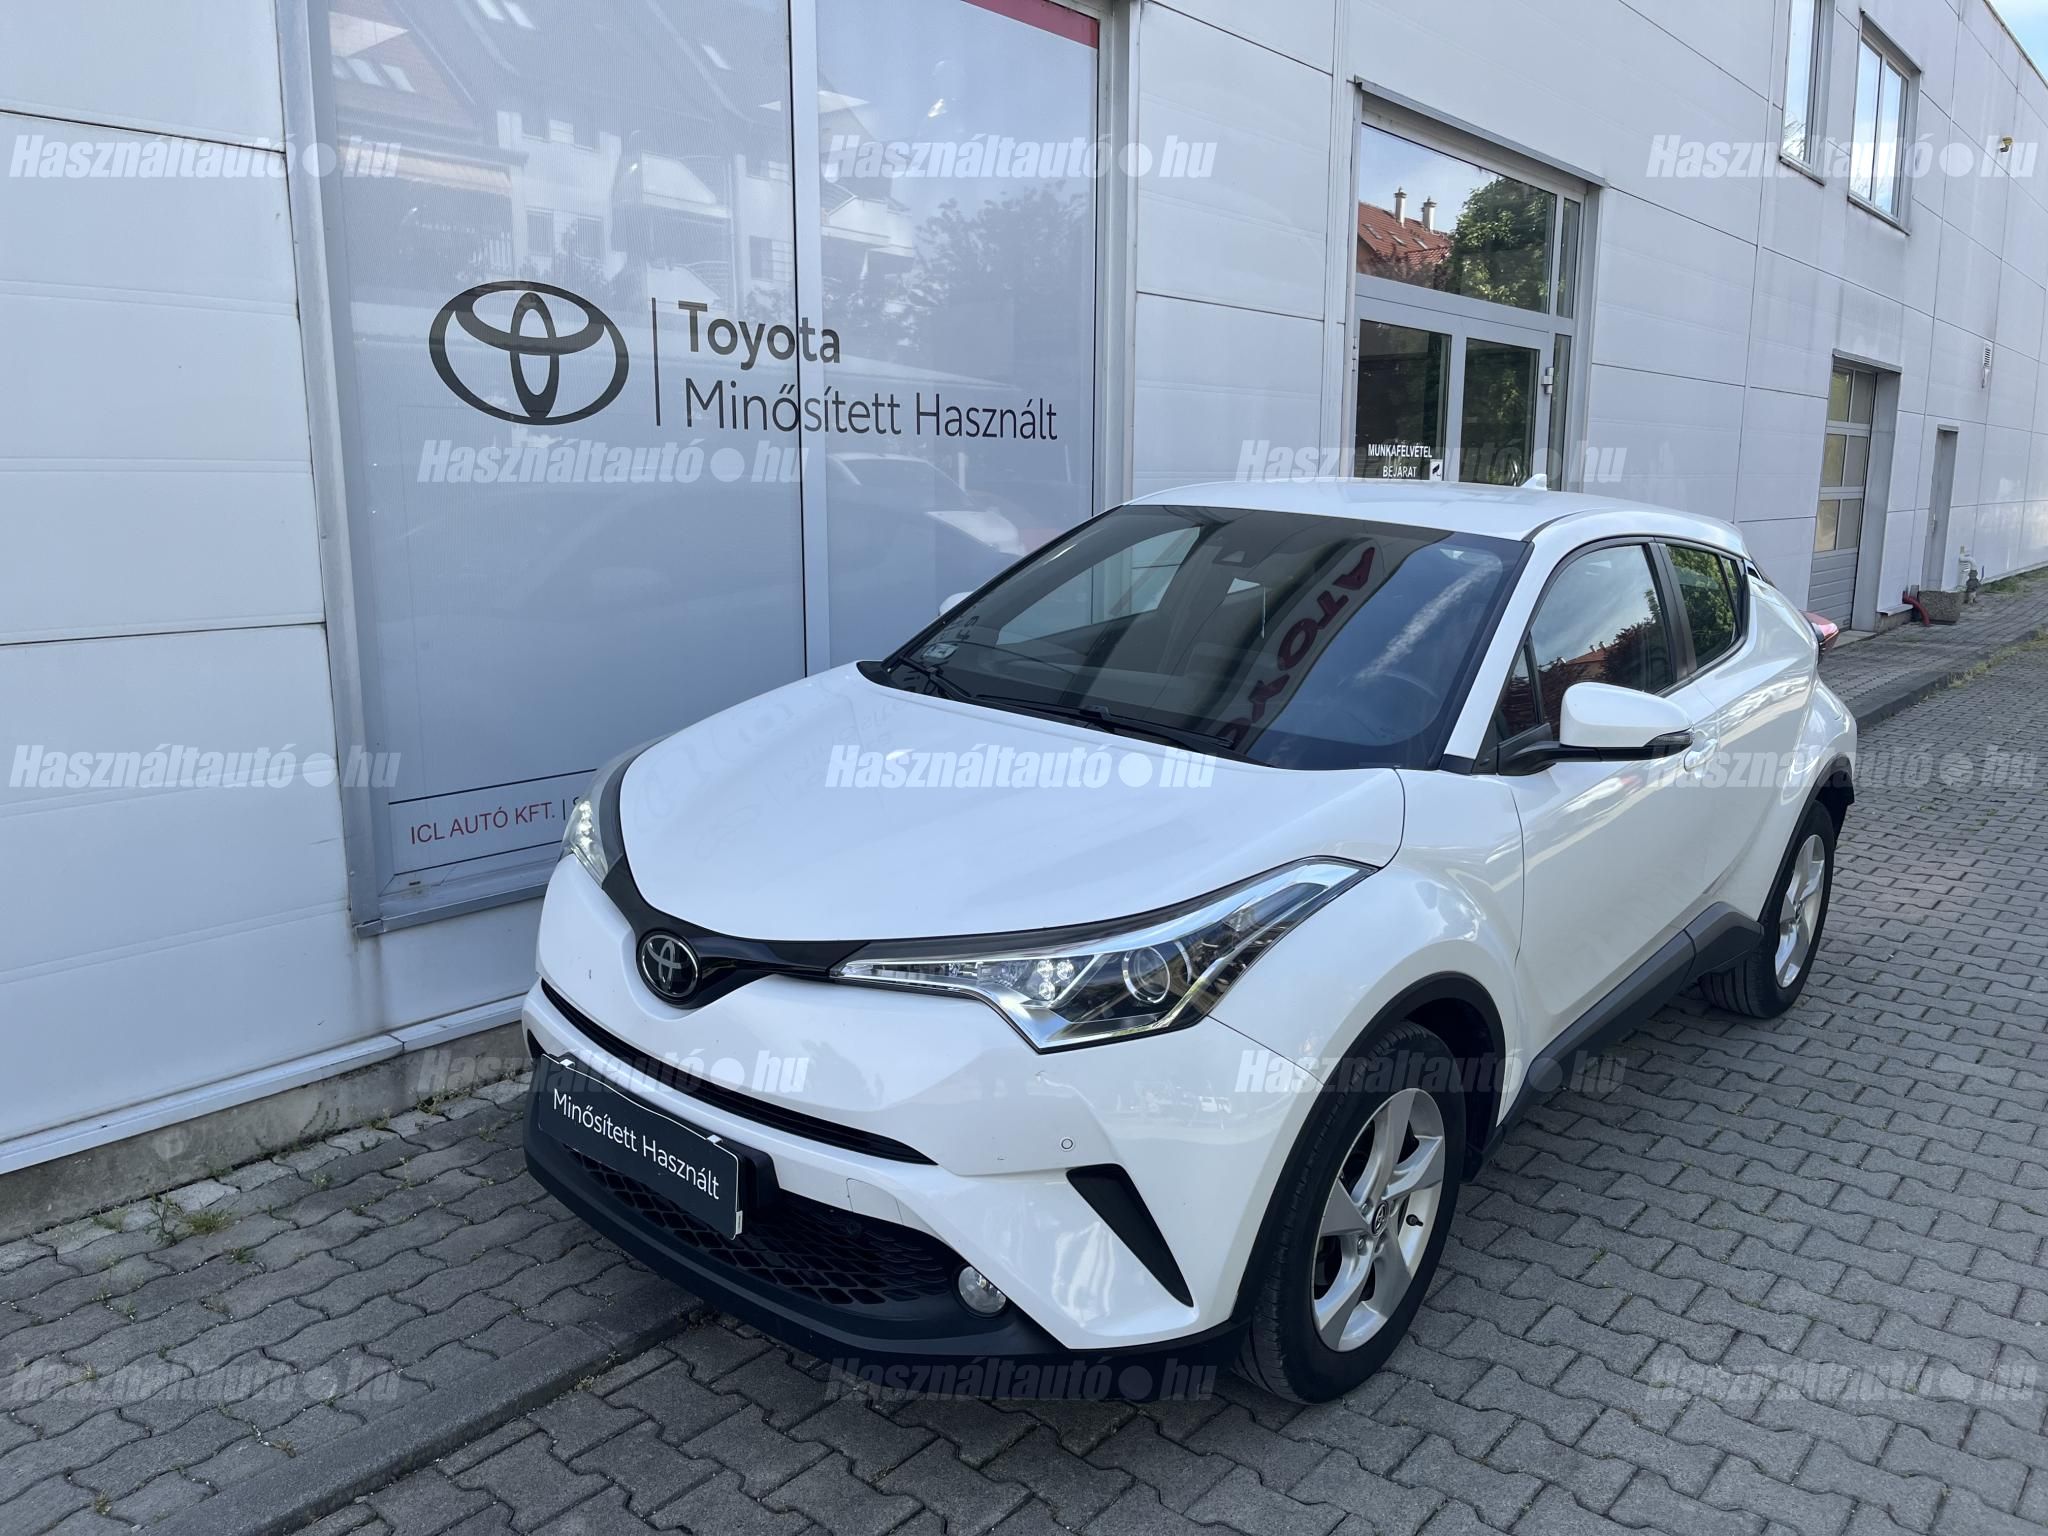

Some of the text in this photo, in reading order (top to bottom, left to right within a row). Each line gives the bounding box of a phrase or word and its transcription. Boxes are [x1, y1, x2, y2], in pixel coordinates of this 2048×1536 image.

[677, 300, 841, 371] Toyota
[685, 377, 1059, 441] Minősített Használt
[1367, 442, 1433, 459] MUNKAFELVÉTEL
[1382, 462, 1417, 478] BEJÁRAT
[411, 822, 445, 845] ICL
[449, 806, 509, 838] AUTÓ
[515, 801, 556, 825] KFT.
[553, 1088, 720, 1200] Minősített Használt
